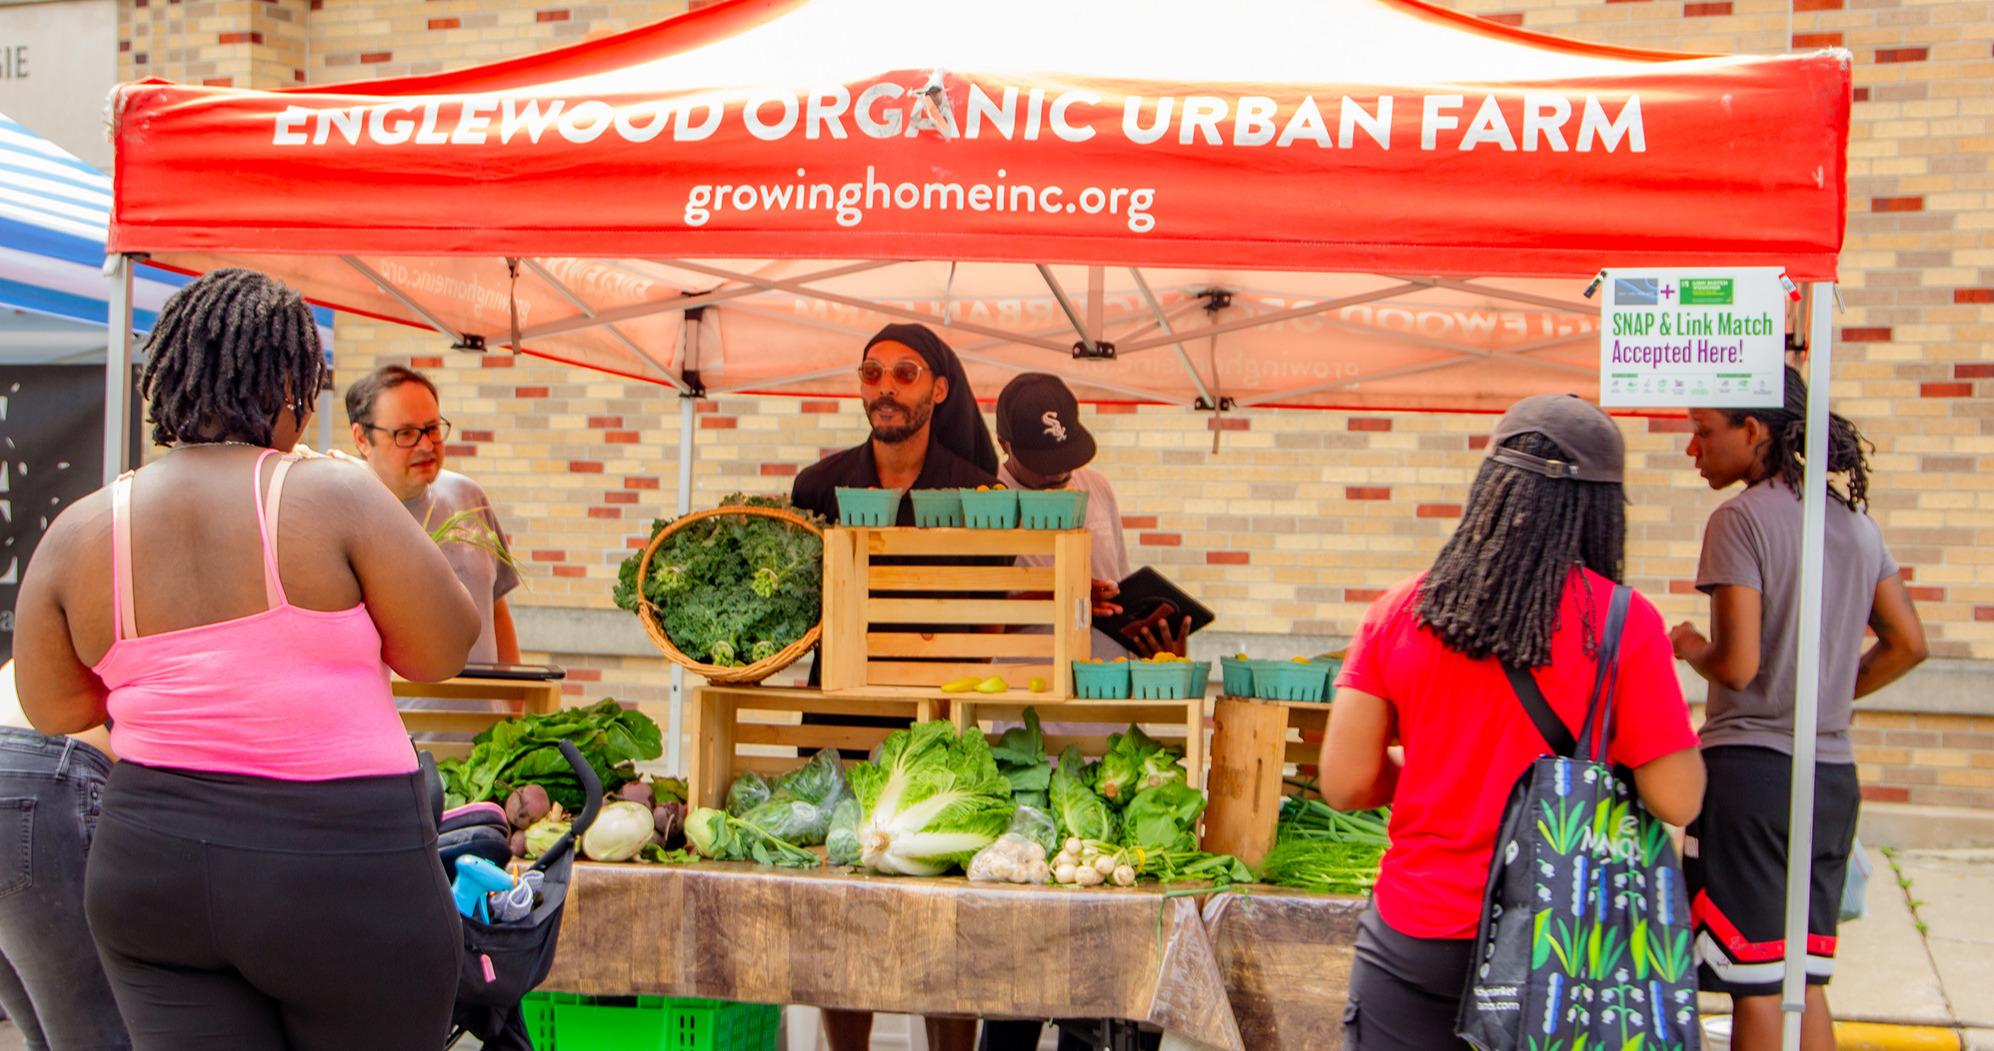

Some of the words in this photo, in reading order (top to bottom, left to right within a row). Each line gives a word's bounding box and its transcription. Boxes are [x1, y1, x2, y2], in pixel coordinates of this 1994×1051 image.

[273, 98, 724, 146] ENGLEWOOD
[743, 82, 1102, 142] ORGANIC
[1122, 95, 1394, 151] URBAN
[1420, 93, 1647, 153] FARM
[684, 165, 1156, 233] growinghomeinc.org
[1613, 312, 1655, 336] SNAP
[1660, 312, 1672, 336] &
[1677, 312, 1713, 336] Link
[1718, 312, 1773, 336] Match
[1612, 339, 1692, 369] Accepted
[1697, 339, 1743, 363] Here!
